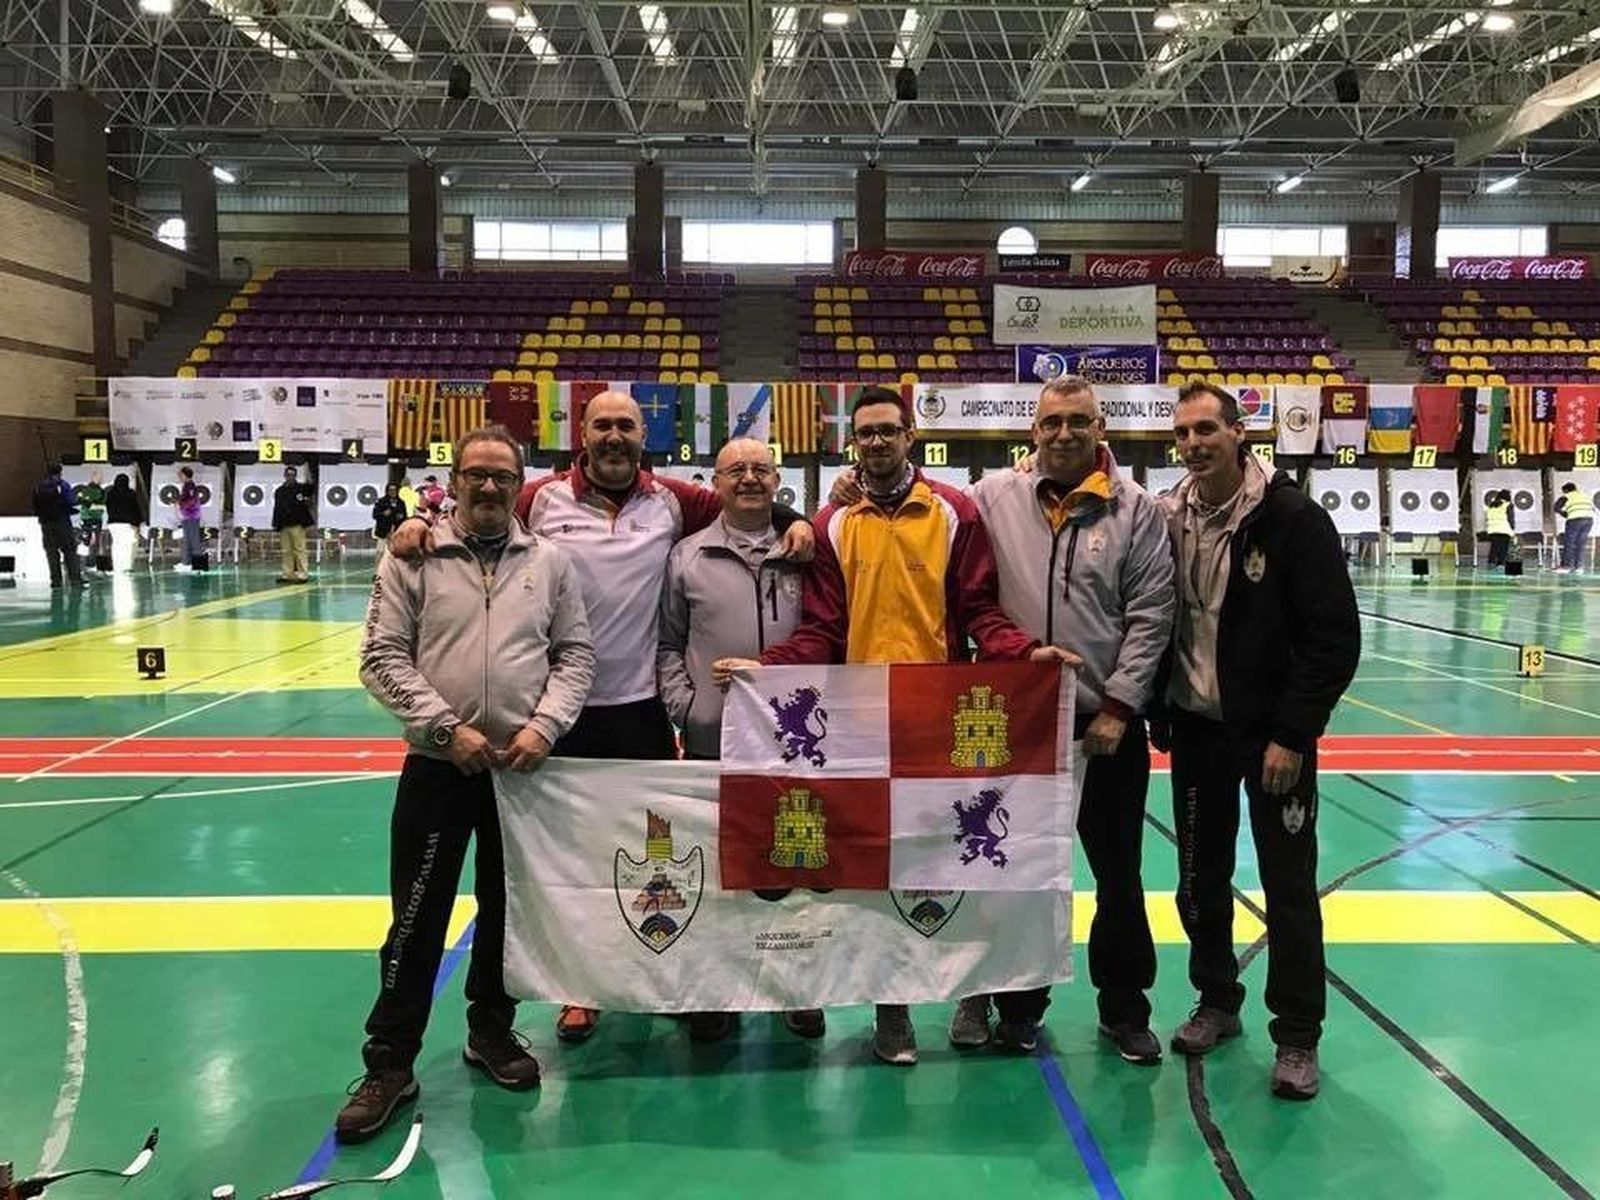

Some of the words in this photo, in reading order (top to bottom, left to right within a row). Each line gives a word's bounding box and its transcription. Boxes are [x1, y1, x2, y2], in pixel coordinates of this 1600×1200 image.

[1059, 315, 1145, 329] DEPORTIVA
[1077, 357, 1148, 370] ARQUEROS
[961, 400, 1013, 417] CAMPEONATO
[1014, 400, 1026, 417] DE
[1148, 401, 1155, 418] Y
[90, 442, 101, 458] 1
[181, 441, 192, 458] 2
[265, 442, 275, 459] 3
[347, 441, 358, 458] 4
[436, 446, 447, 461] 5
[680, 444, 691, 461] 8
[927, 447, 945, 463] 11
[1338, 447, 1356, 464] 16
[1416, 449, 1434, 464] 17
[1499, 448, 1518, 464] 18
[1578, 447, 1596, 463] 19
[145, 652, 157, 668] 6
[1525, 650, 1542, 667] 13
